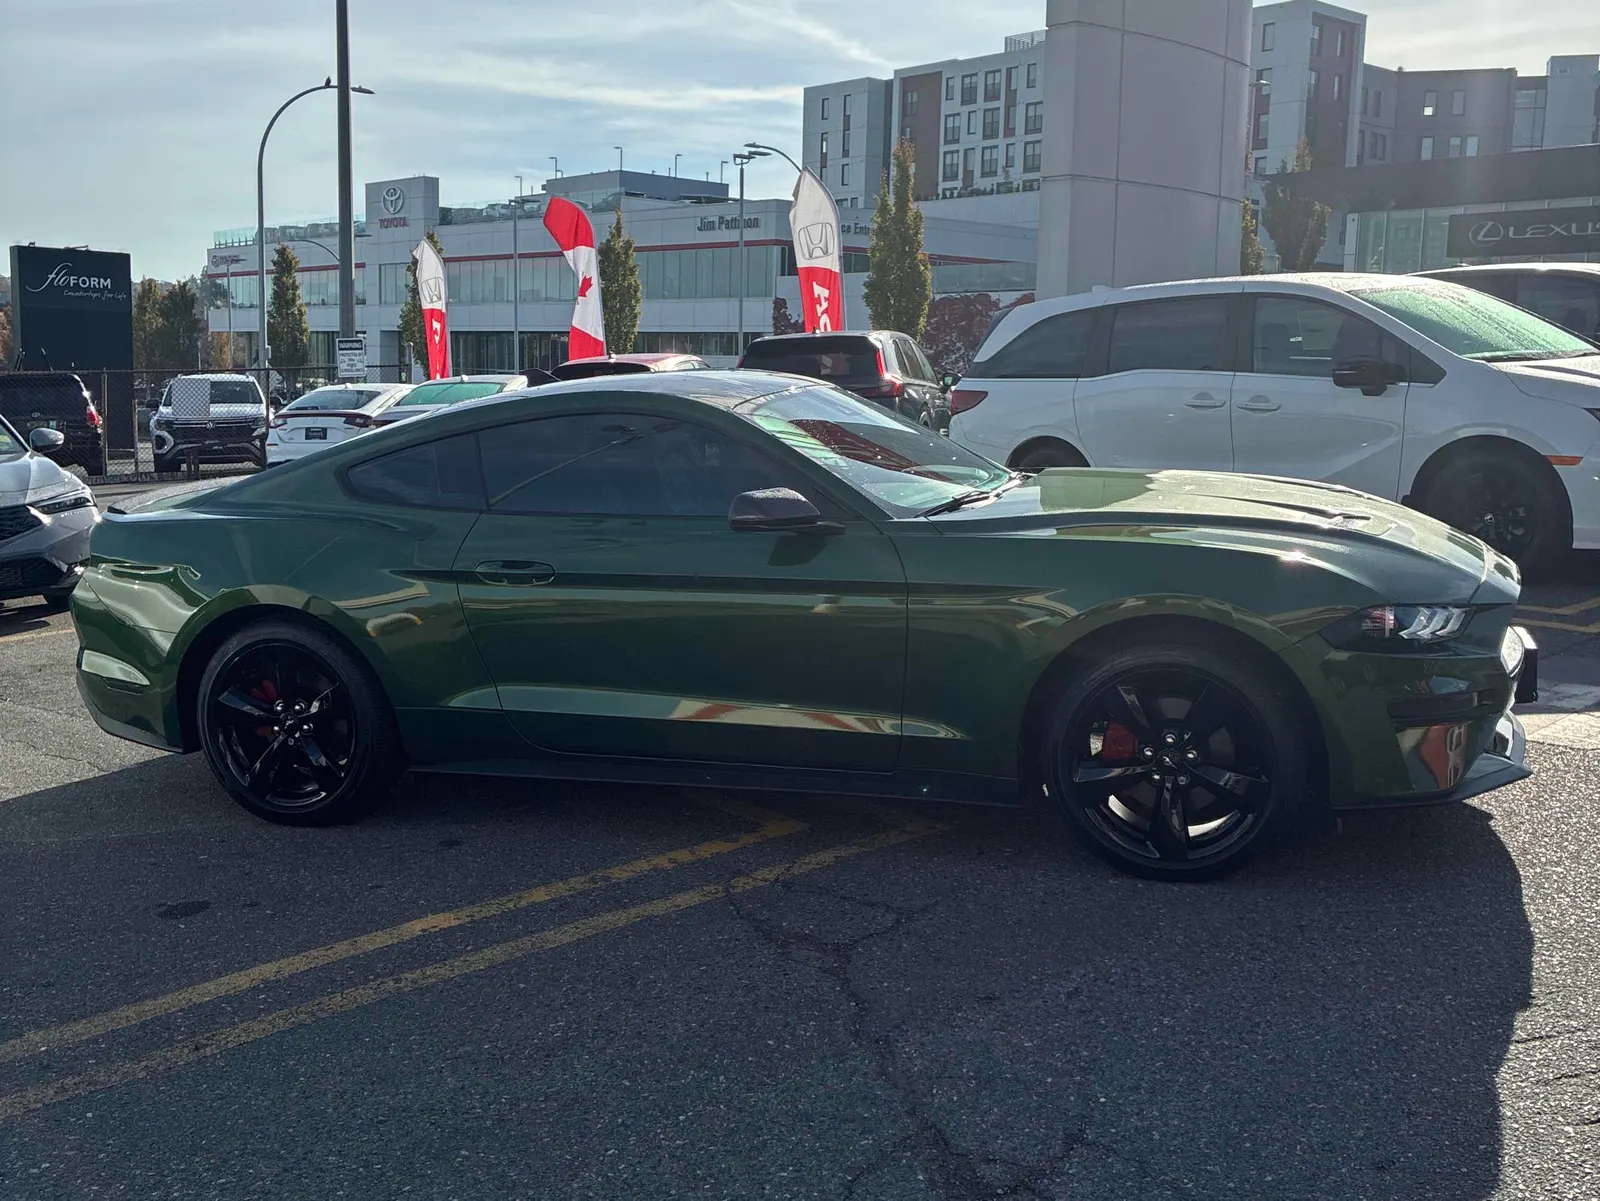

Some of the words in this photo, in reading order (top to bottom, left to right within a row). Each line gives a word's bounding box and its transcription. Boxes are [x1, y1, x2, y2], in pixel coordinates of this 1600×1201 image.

[378, 216, 409, 229] TOYOTA
[697, 216, 715, 231] Jim
[1508, 222, 1600, 239] LEXU
